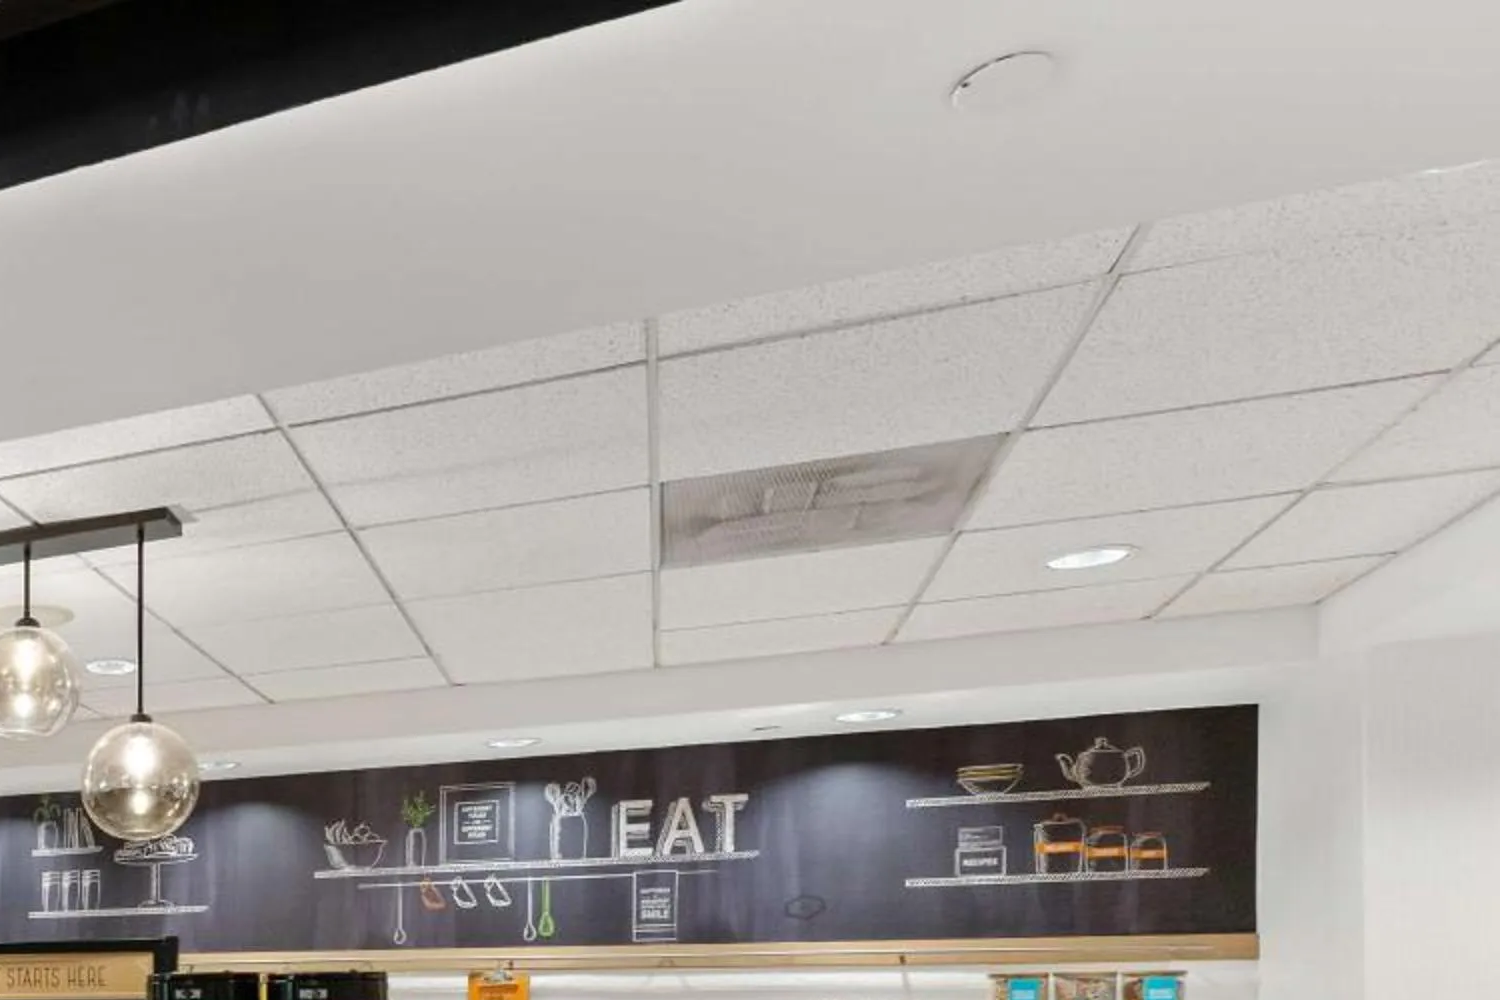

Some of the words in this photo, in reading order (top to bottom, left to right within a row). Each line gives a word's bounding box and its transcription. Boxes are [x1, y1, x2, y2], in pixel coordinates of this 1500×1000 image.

[611, 793, 749, 860] EAT
[6, 966, 62, 989] STARTS
[67, 965, 107, 988] HERE
